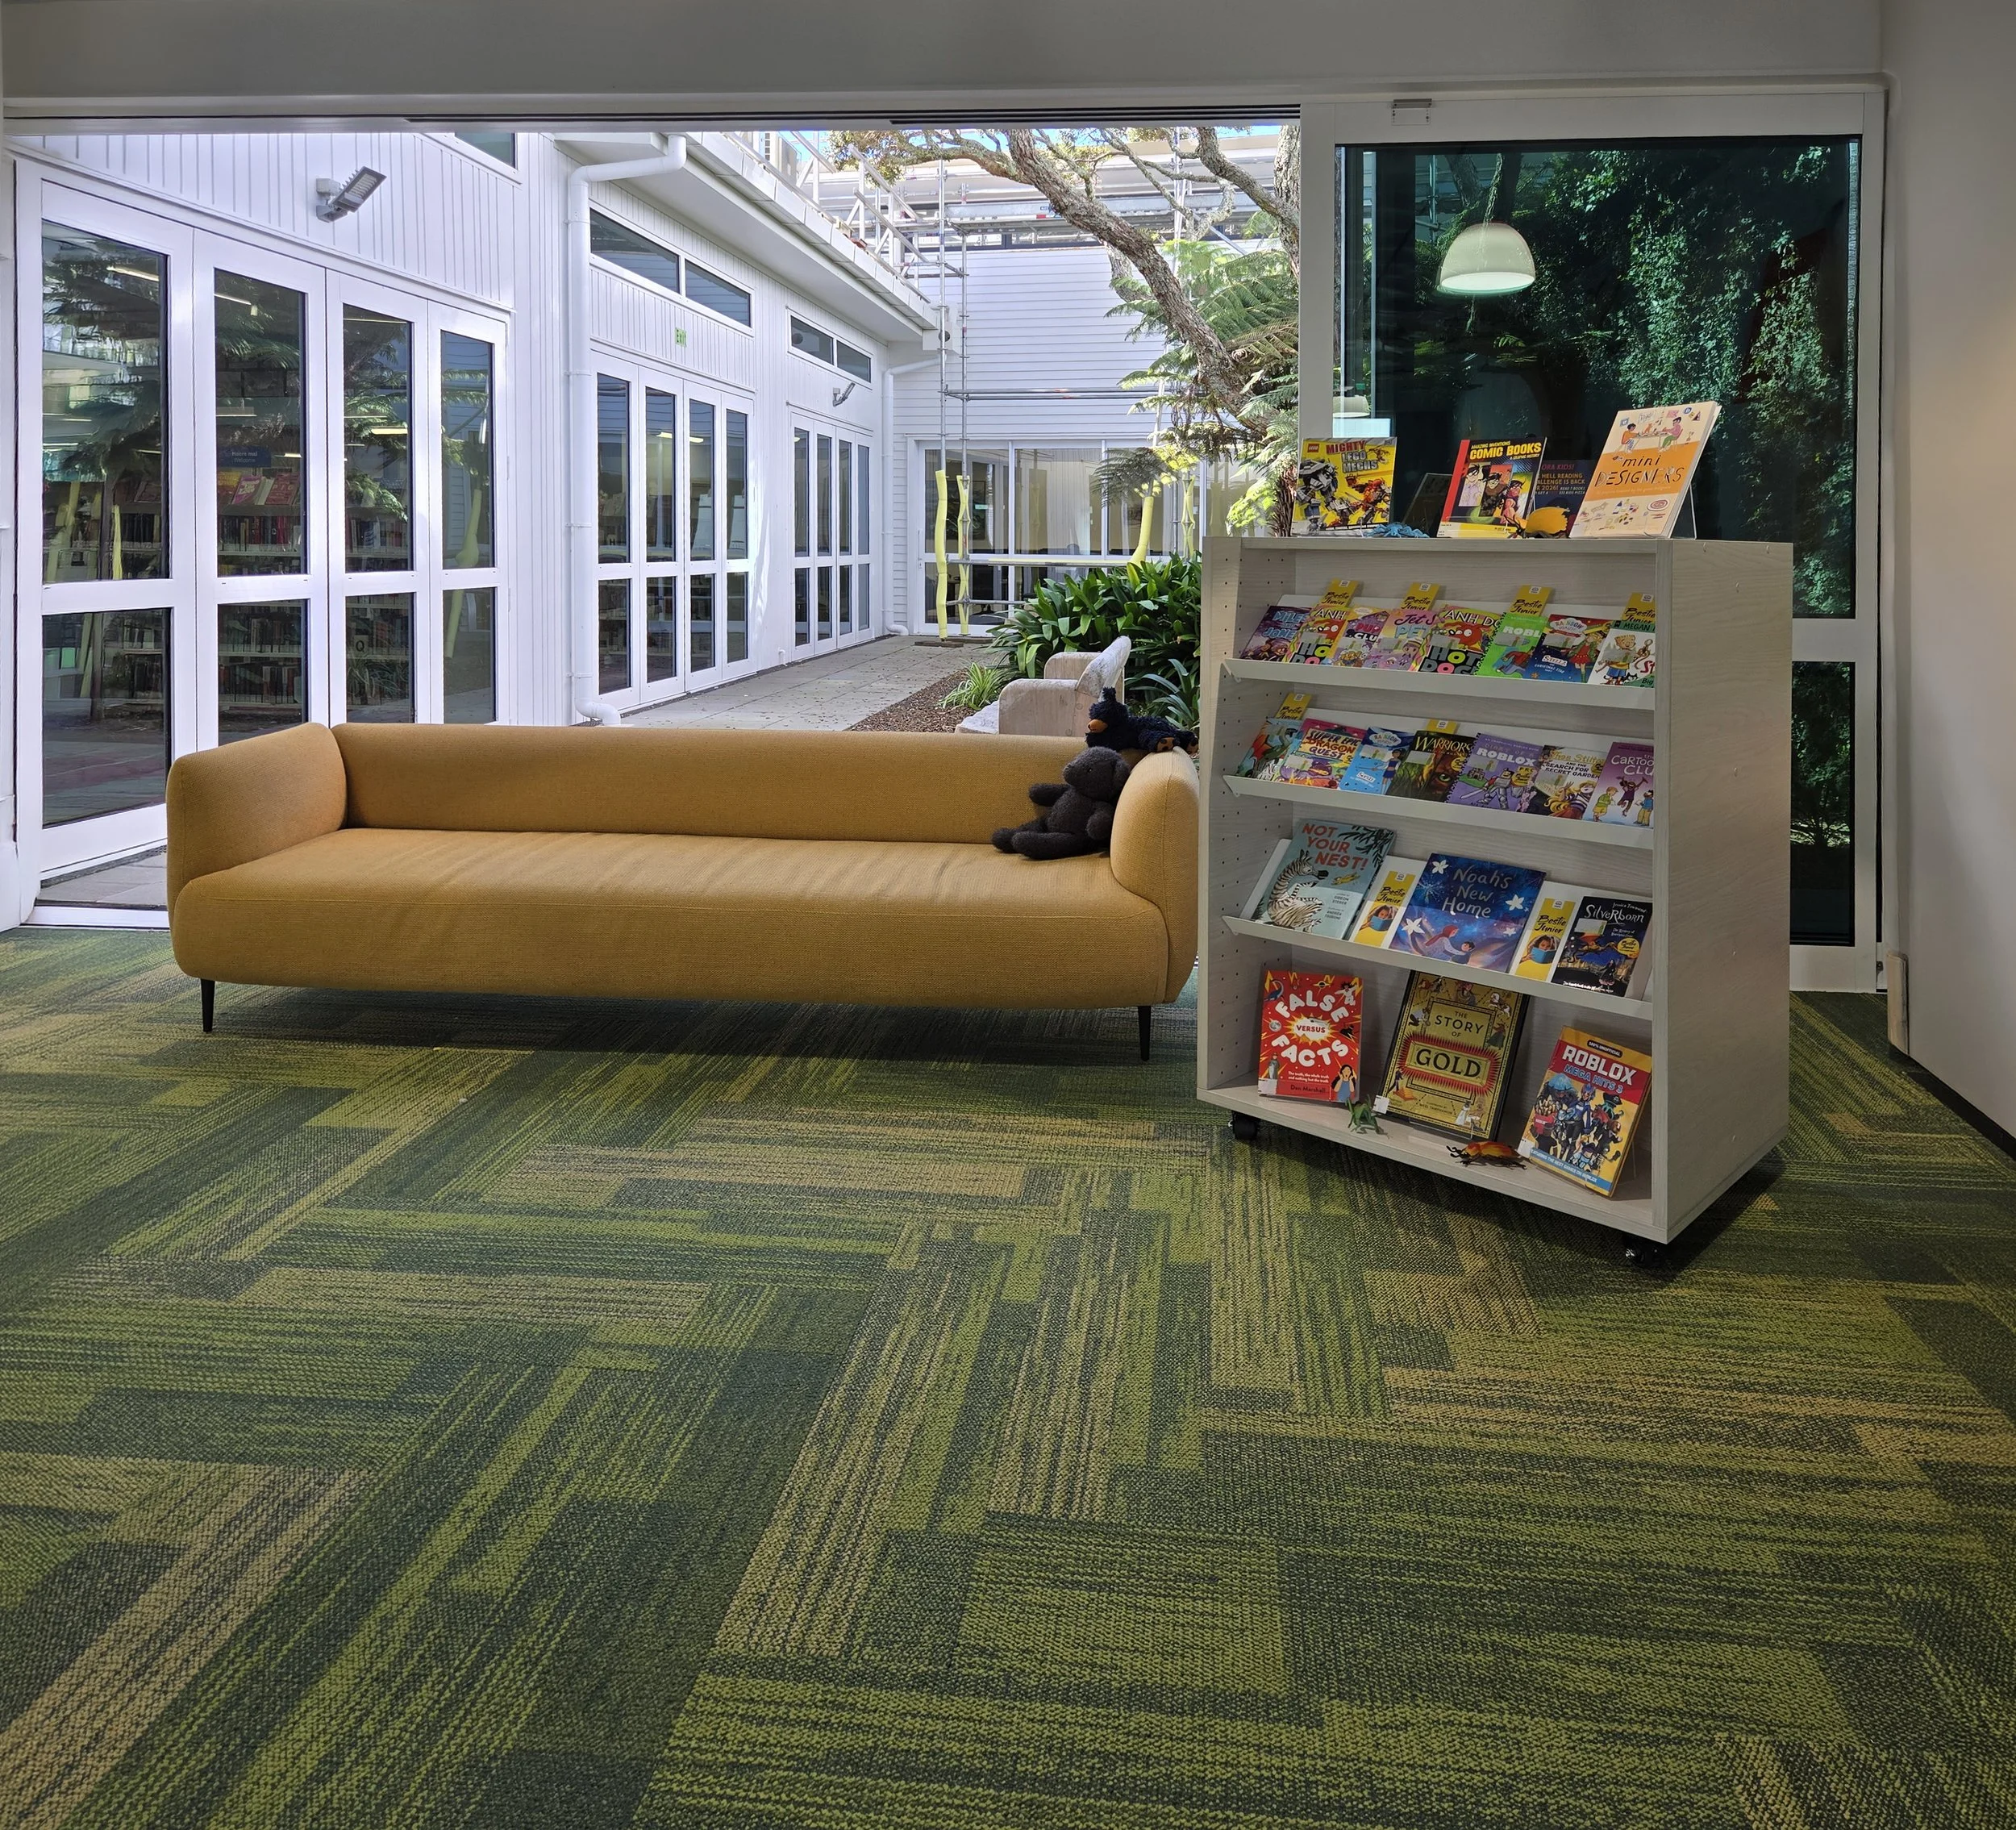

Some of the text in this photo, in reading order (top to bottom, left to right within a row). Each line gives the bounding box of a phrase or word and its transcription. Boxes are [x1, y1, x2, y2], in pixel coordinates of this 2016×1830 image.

[1326, 440, 1366, 454] MIGHTY
[1469, 442, 1542, 460] COMIC BOOKS
[1341, 451, 1367, 462] LEGO
[1622, 454, 1661, 468] mini
[1343, 461, 1378, 473] MECHS
[1594, 465, 1685, 487] DESIGNERS
[1401, 602, 1426, 611] Junior
[1405, 596, 1431, 605] Bestie
[1512, 598, 1543, 608] Bestie
[1314, 609, 1346, 619] ANH
[1444, 610, 1479, 623] ANH
[1510, 606, 1538, 615] Junior
[1625, 608, 1656, 619] Bestie
[1622, 614, 1652, 623] Junior
[1623, 623, 1651, 632] MEGAN
[356, 640, 364, 652] Q
[1428, 645, 1482, 666] HOT
[1310, 729, 1361, 746] SUPER EPIC
[1302, 736, 1356, 753] DRAGON
[1309, 746, 1346, 759] QUEST
[1477, 747, 1537, 766] ROBLOX
[1545, 762, 1573, 771] SEARCH
[1545, 767, 1572, 775] SECRET
[1302, 823, 1338, 837] NOT
[1306, 836, 1350, 853] YOUR
[1315, 852, 1369, 871] NEST!
[1453, 863, 1513, 889] Noah's
[1381, 886, 1406, 898] Bestie
[1456, 883, 1493, 902] New
[1376, 894, 1401, 904] Junior
[1442, 896, 1492, 919] Home
[1537, 914, 1568, 927] Bestie
[1534, 923, 1564, 935] Junior
[1275, 990, 1350, 1023] FALSE
[1455, 1011, 1468, 1019] THE
[1296, 1025, 1326, 1033] VERSUS
[1435, 1015, 1485, 1034] STORY
[1271, 1034, 1349, 1067] FACTS
[1599, 1044, 1621, 1057] UNOFFICIAL
[1416, 1048, 1481, 1078] GOLD
[1561, 1044, 1637, 1085] ROBLOX
[1564, 1064, 1624, 1094] MEGA HITS 3
[1303, 1085, 1325, 1093] Marshall
